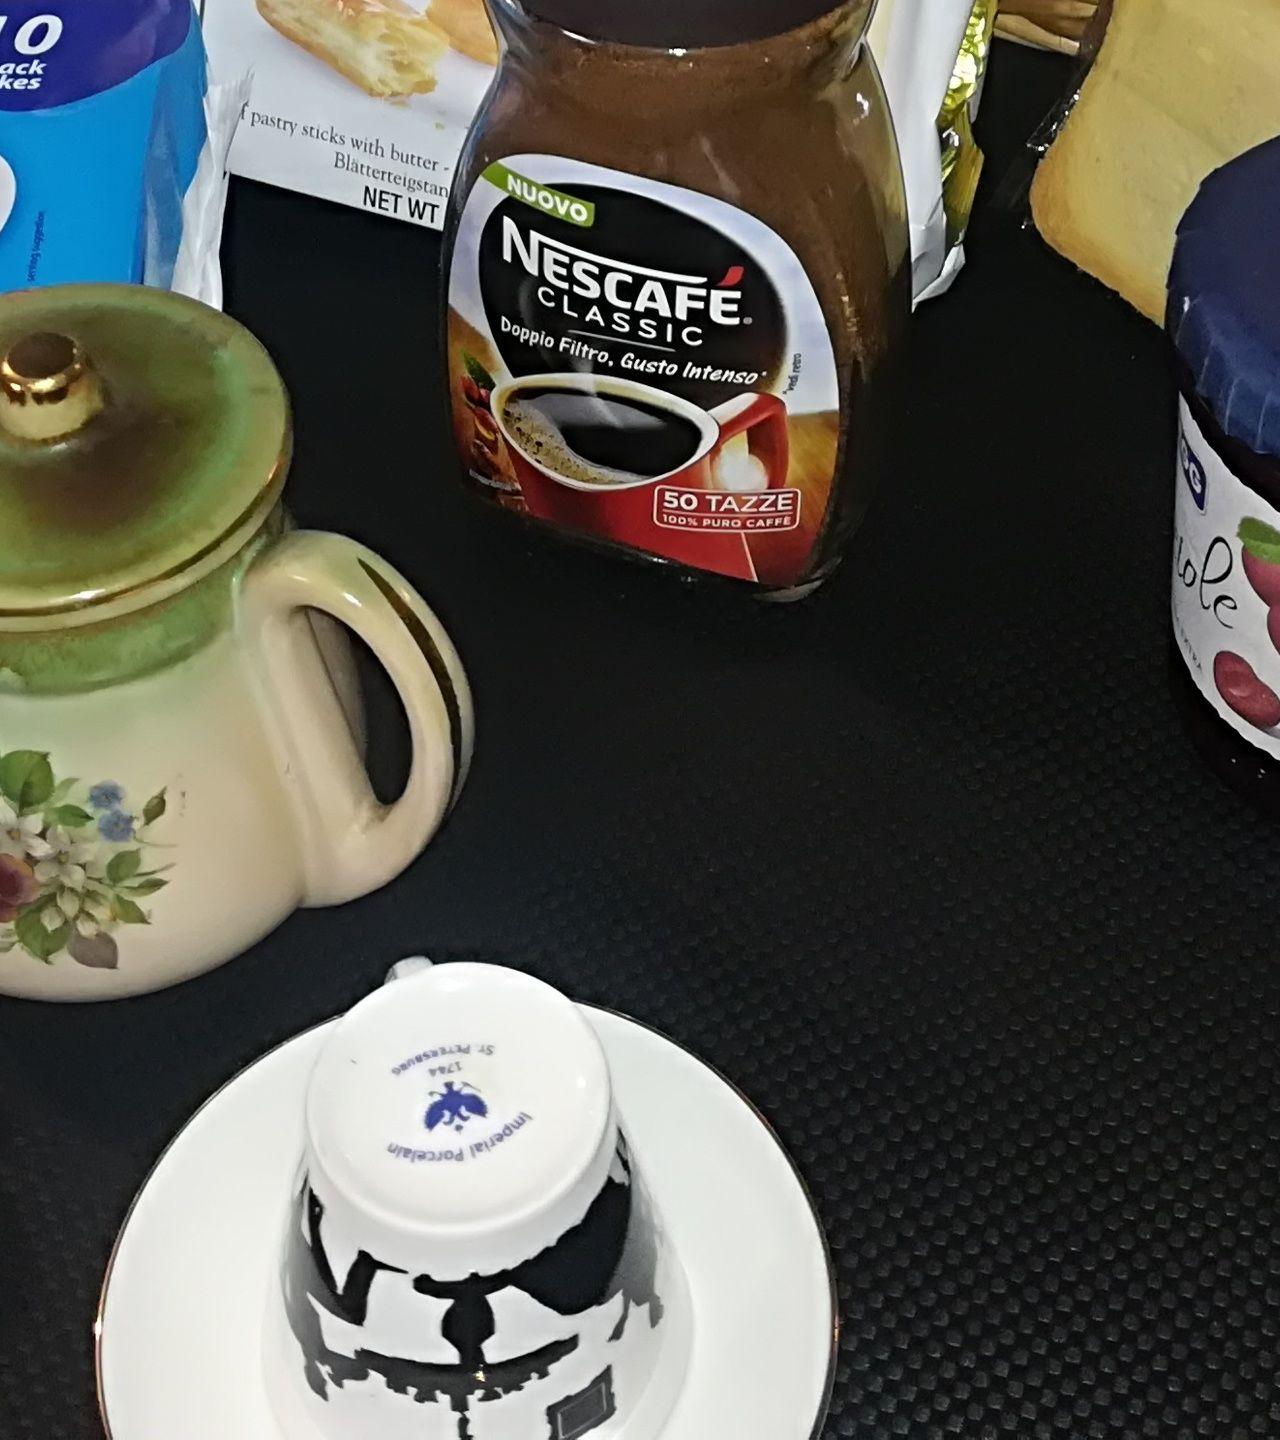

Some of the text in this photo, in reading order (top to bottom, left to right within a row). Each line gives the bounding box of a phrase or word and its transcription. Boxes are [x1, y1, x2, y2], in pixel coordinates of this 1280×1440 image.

[251, 111, 440, 173] pastry sticks with butter
[333, 151, 450, 198] Blätterteigstan
[507, 174, 587, 222] NUOVO
[363, 185, 440, 224] NET WT
[502, 216, 744, 326] NESCAFÉ
[537, 287, 703, 346] CLASSIC
[500, 315, 554, 349] Doppio
[558, 336, 614, 367] Filtro,
[621, 352, 678, 376] Gusto
[663, 491, 793, 512] 50 TAZZE
[663, 514, 697, 526] 100%
[703, 518, 741, 527] PURO
[392, 1044, 470, 1076] PETERSBURG
[428, 1061, 462, 1077] 1744
[387, 1112, 533, 1163] Imperial Porcelain
